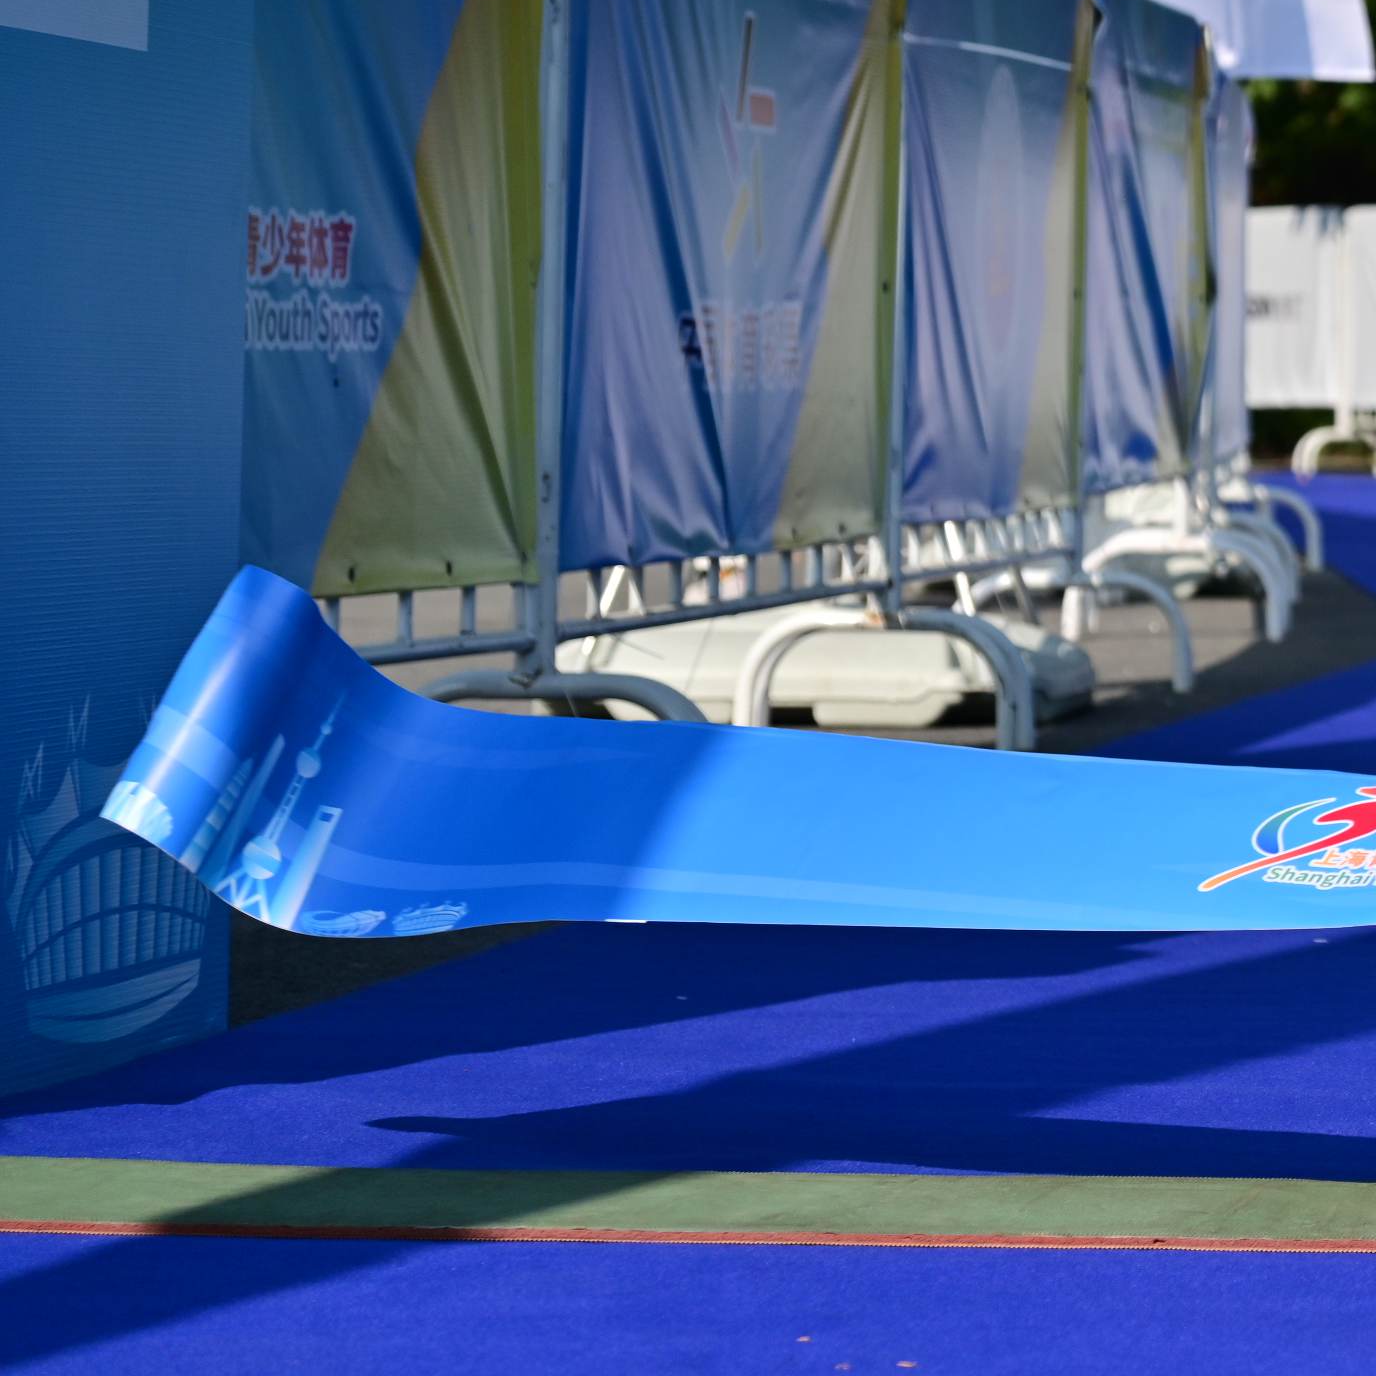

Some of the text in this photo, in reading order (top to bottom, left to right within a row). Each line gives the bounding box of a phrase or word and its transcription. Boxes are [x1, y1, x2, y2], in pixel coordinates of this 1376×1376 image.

[255, 297, 380, 354] Youth Sports
[1268, 867, 1370, 887] Shanghai
